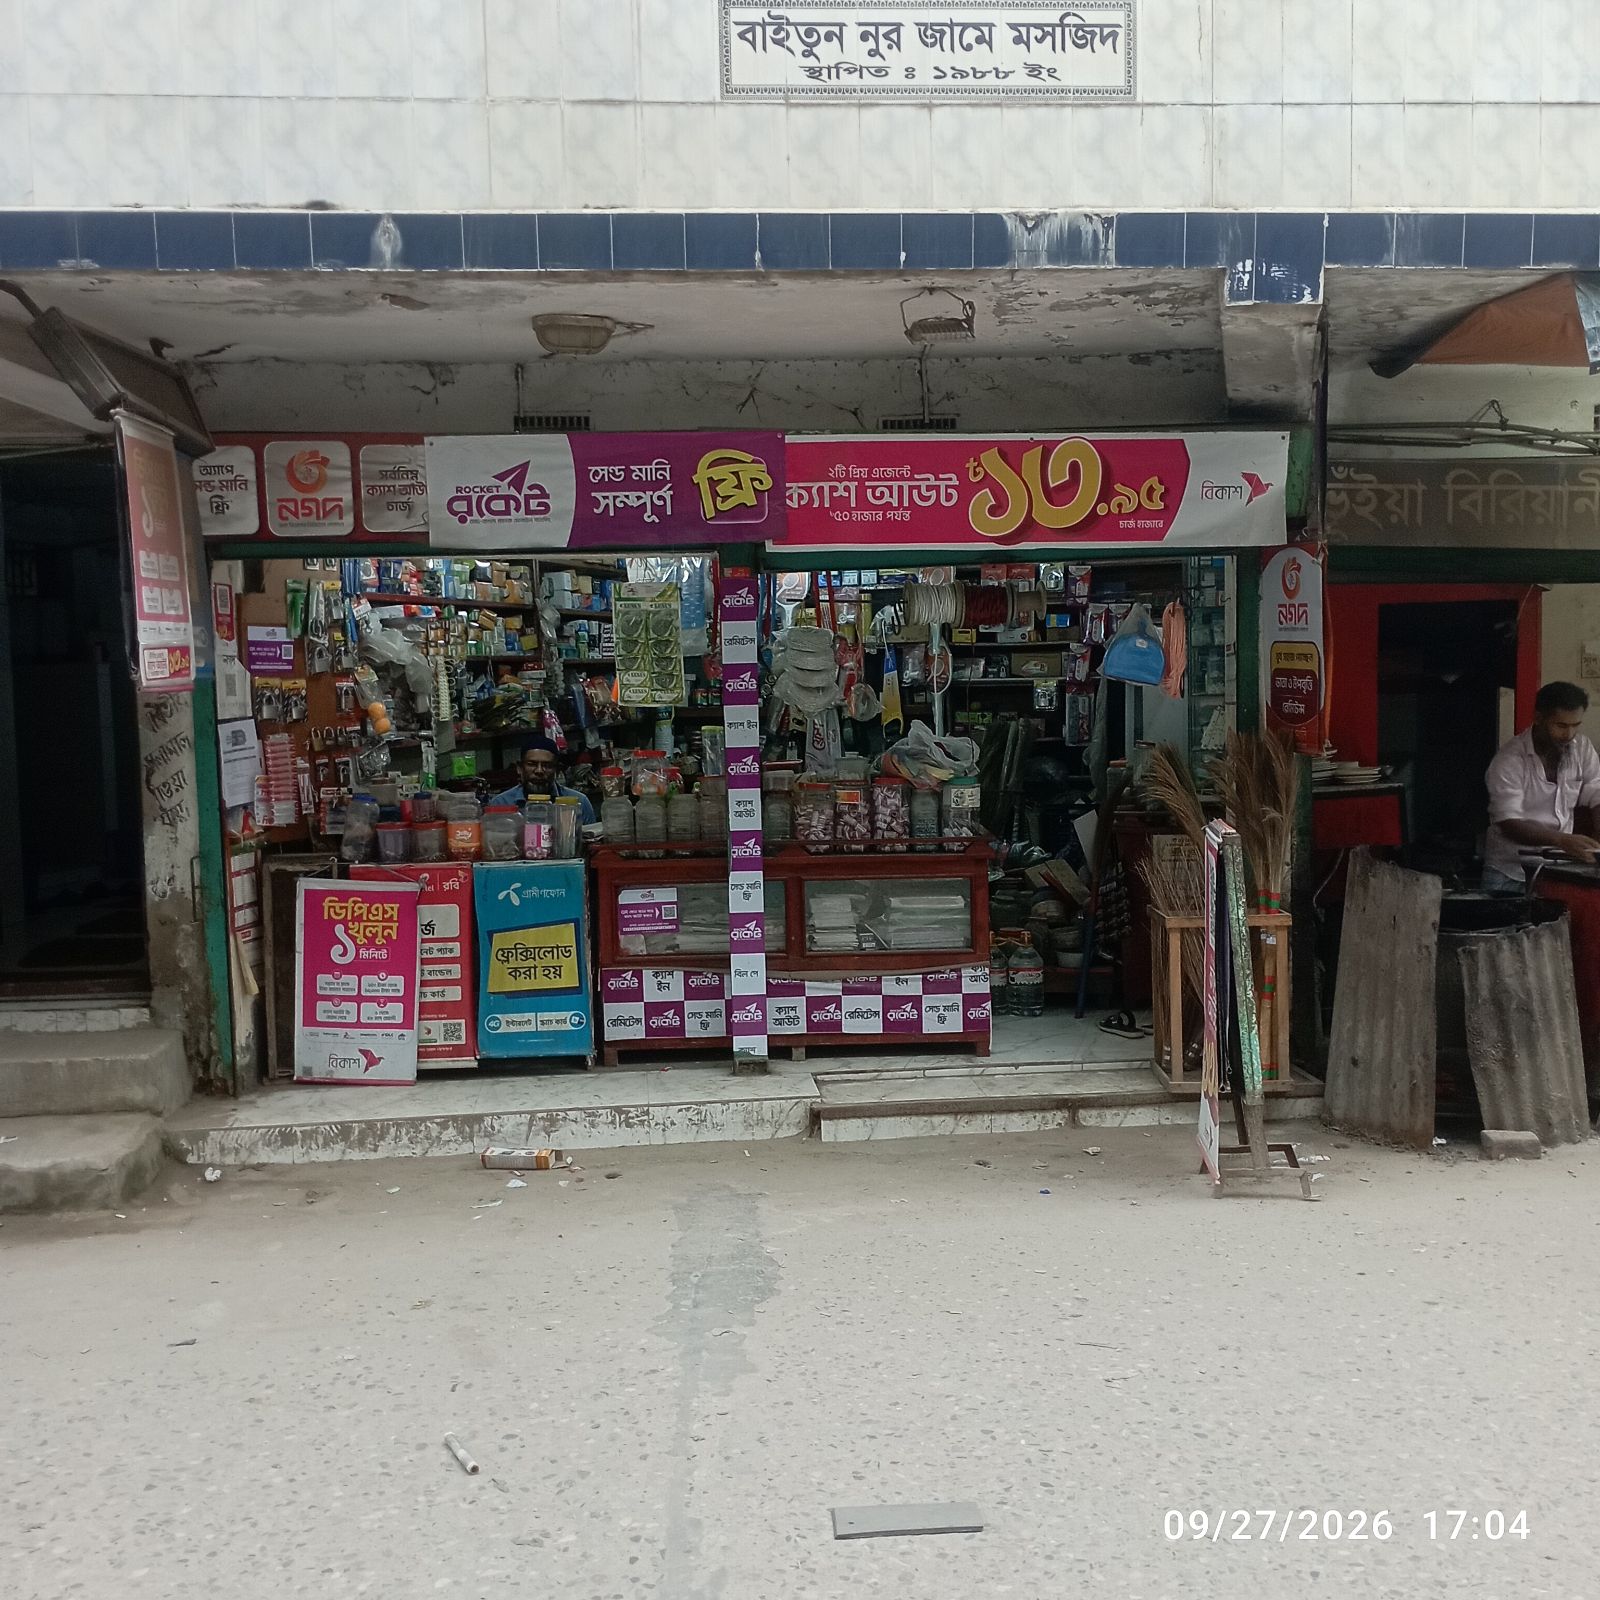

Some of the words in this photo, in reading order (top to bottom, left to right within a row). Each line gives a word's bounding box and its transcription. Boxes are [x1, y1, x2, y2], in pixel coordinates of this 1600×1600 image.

[733, 11, 847, 60] বাইতুন
[855, 21, 903, 60] নুর
[914, 21, 999, 54] জামে
[1006, 11, 1122, 54] মসজিদ
[800, 63, 891, 82] স্থাপিত
[933, 66, 1015, 80] ১৯৮৮
[1022, 62, 1061, 82] ইং
[630, 458, 671, 482] মানি
[828, 464, 846, 479] ২টি
[849, 465, 868, 479] প্রিয়
[218, 474, 248, 492] মানি
[366, 484, 395, 496] ক্যাশ
[399, 481, 428, 496] আউ
[455, 485, 502, 494] ROCKET
[692, 448, 773, 520] ফ্রি
[785, 481, 858, 508] ক্যাশ
[865, 473, 959, 508] আউট
[1201, 480, 1242, 500] বিকাশ
[276, 497, 344, 521] নগদ
[446, 483, 551, 524] রকেট
[591, 483, 674, 523] সম্পূর্ণ
[851, 510, 882, 522] হাজার
[886, 508, 911, 521] পর্যন্ত
[1277, 603, 1309, 626] নগদ
[442, 878, 460, 891] রবি
[322, 896, 399, 920] ডিপিএস
[348, 921, 398, 944] খুলুন
[359, 947, 387, 960] মিনিটে
[508, 965, 538, 981] করা
[542, 963, 563, 980] হয়
[734, 968, 748, 978] বিল
[775, 1005, 798, 1015] ক্যাশ
[772, 1016, 800, 1027] আউট
[329, 1053, 360, 1069] বিকাশ
